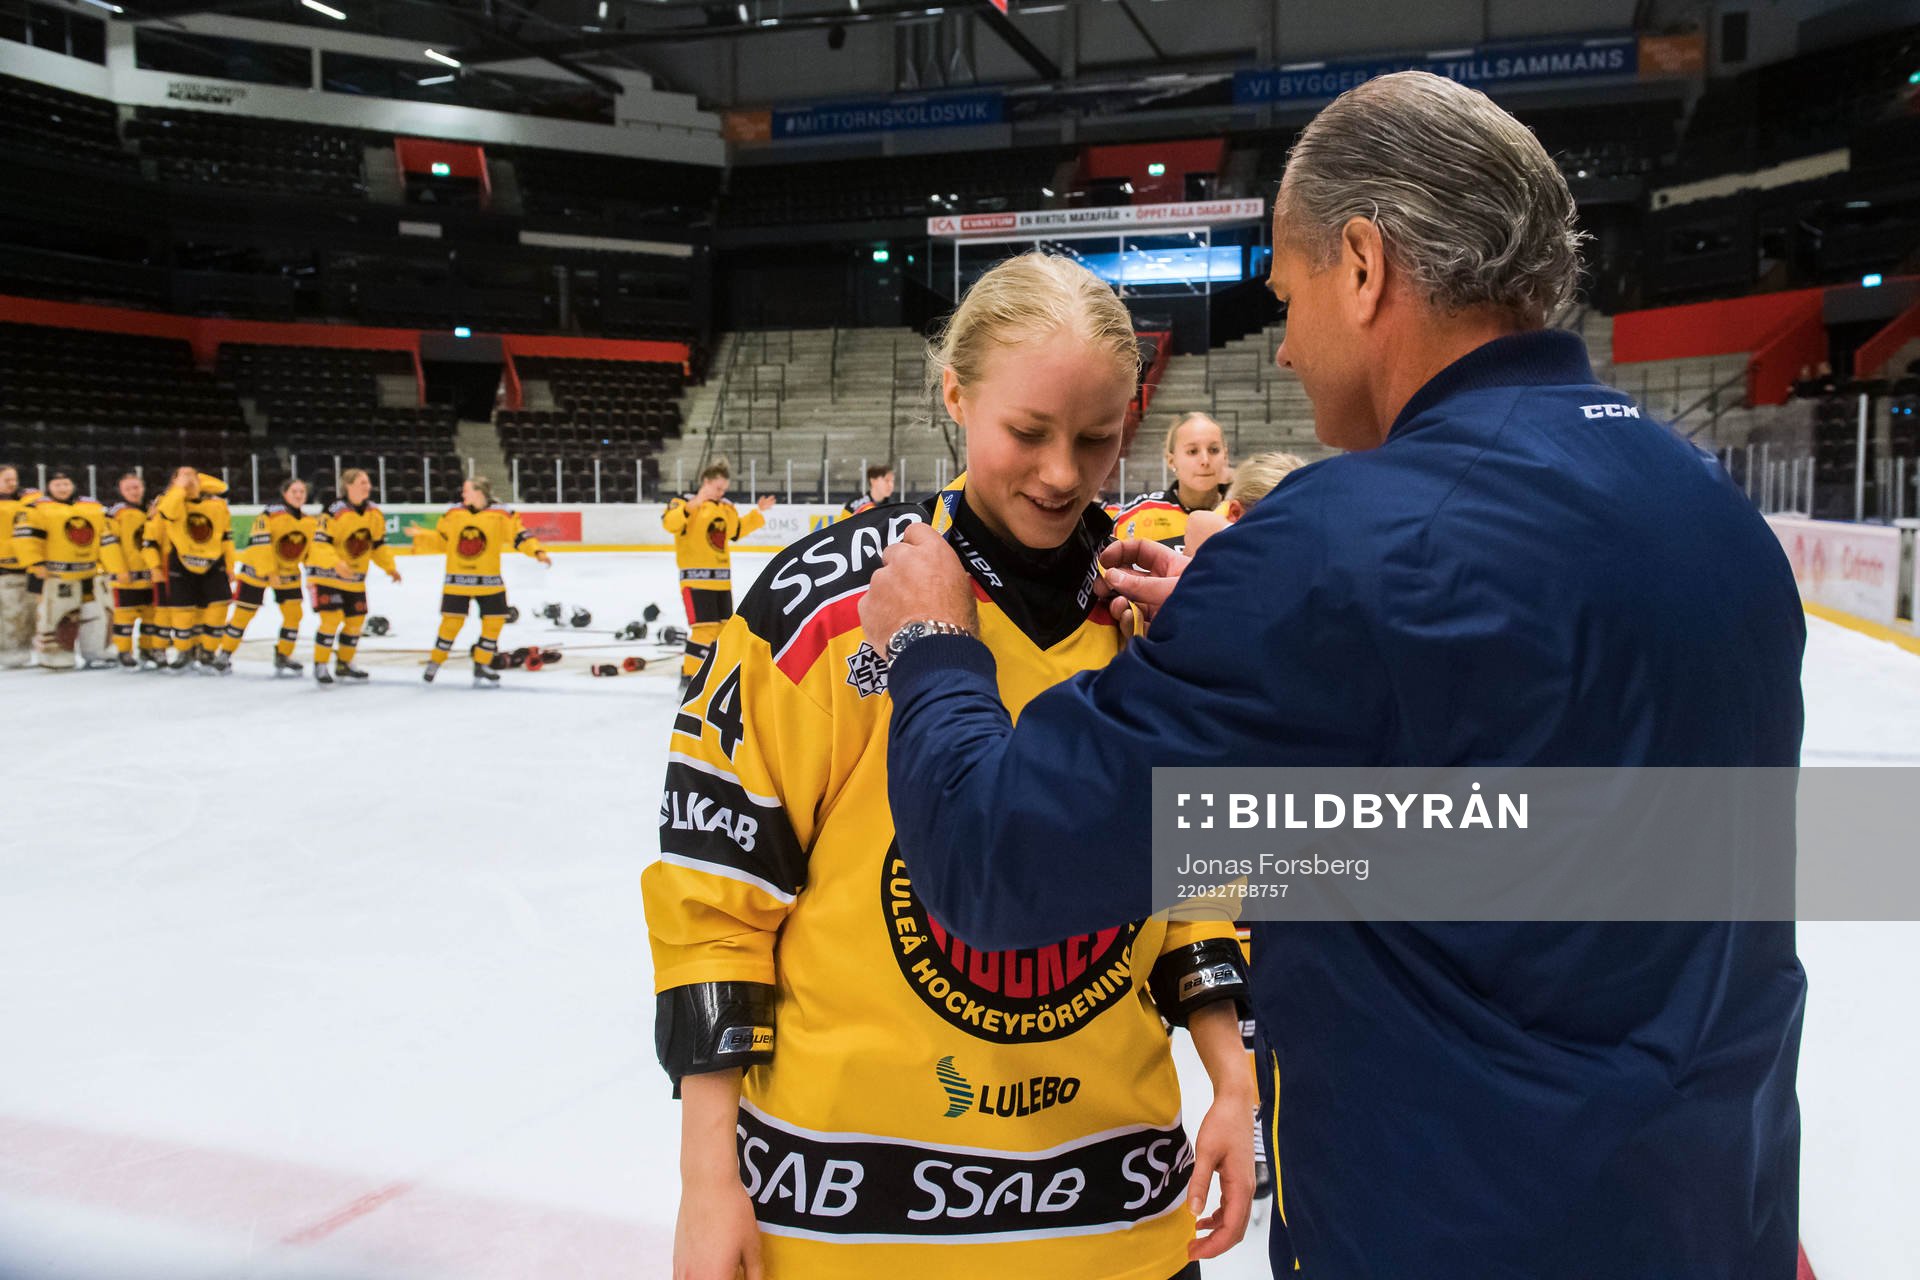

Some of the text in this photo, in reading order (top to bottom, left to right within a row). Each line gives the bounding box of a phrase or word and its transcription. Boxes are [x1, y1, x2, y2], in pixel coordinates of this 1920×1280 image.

[1445, 50, 1624, 80] TILLSAMMANS
[932, 218, 955, 231] ICA
[965, 216, 1013, 228] KVANTUM
[1020, 215, 1033, 225] EN
[1038, 213, 1066, 224] RIKTIG
[1069, 209, 1120, 222] MATAFFÄR
[1135, 206, 1167, 219] ÖPPET
[1170, 206, 1193, 218] ALLA
[1196, 203, 1231, 216] DAGAR
[1579, 404, 1640, 419] CCM
[763, 518, 799, 530] OMS
[951, 527, 1004, 588] UER
[671, 791, 759, 852] LKAB
[889, 858, 929, 955] LULEÅ
[979, 1076, 1081, 1118] LULEBO
[736, 1124, 865, 1218] SAB
[906, 1159, 1086, 1221] SSAB
[1121, 1138, 1195, 1210] SSA
